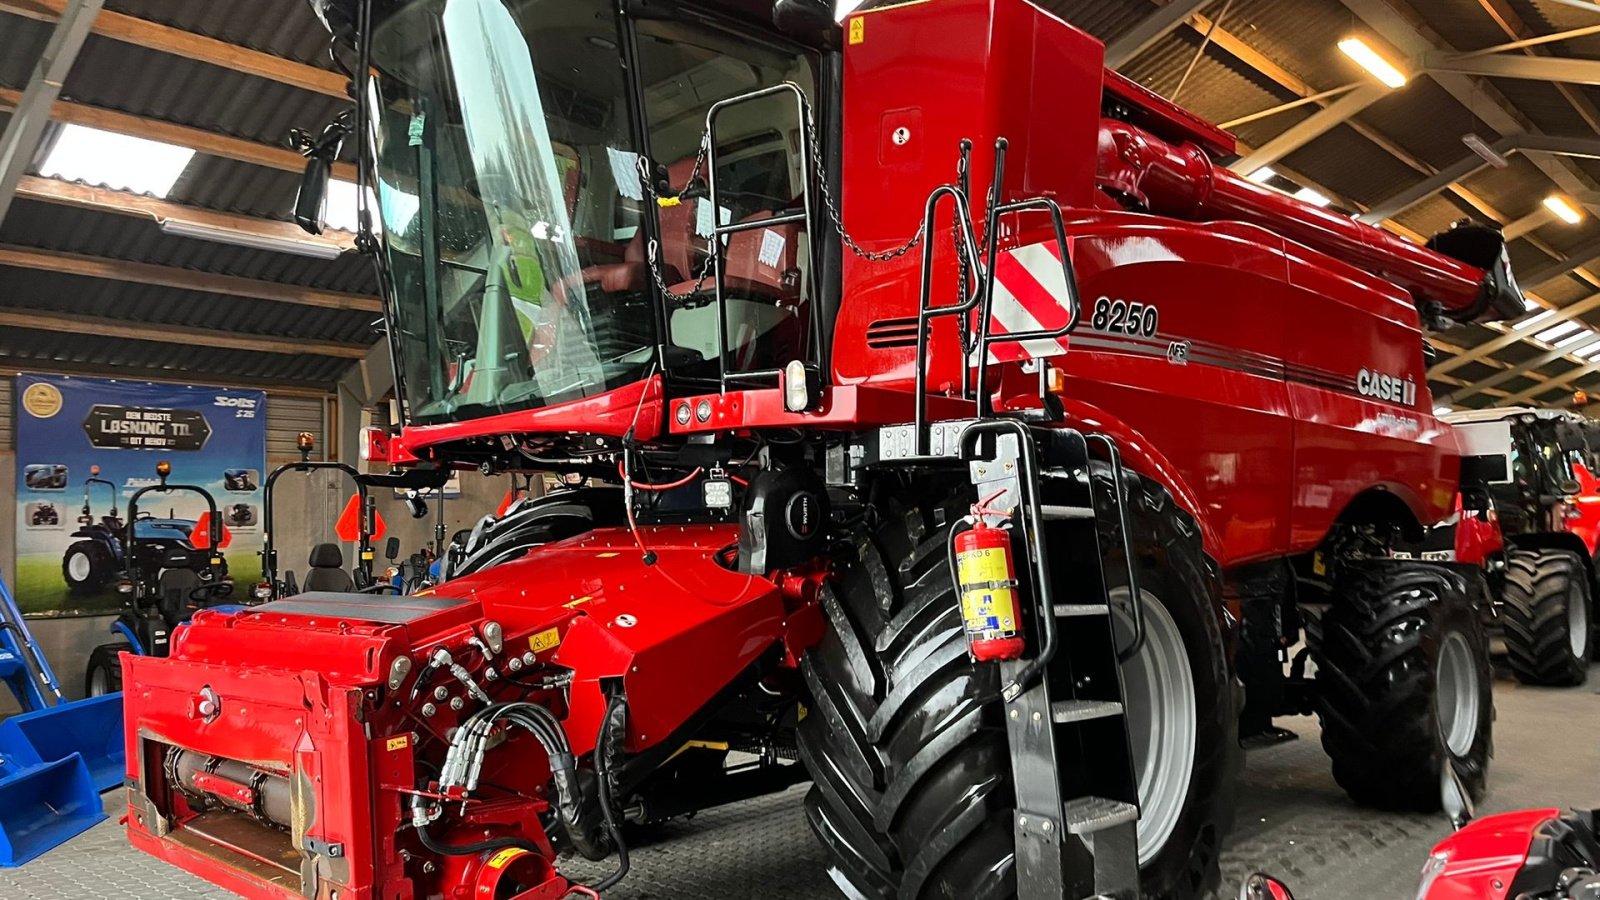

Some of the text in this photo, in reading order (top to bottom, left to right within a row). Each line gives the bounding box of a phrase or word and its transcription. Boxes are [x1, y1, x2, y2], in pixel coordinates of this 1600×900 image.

[1092, 296, 1158, 338] 8250
[1168, 341, 1186, 359] AFS
[1357, 368, 1402, 403] CASE
[101, 420, 194, 436] LØSNING TIL
[984, 549, 991, 557] 6
